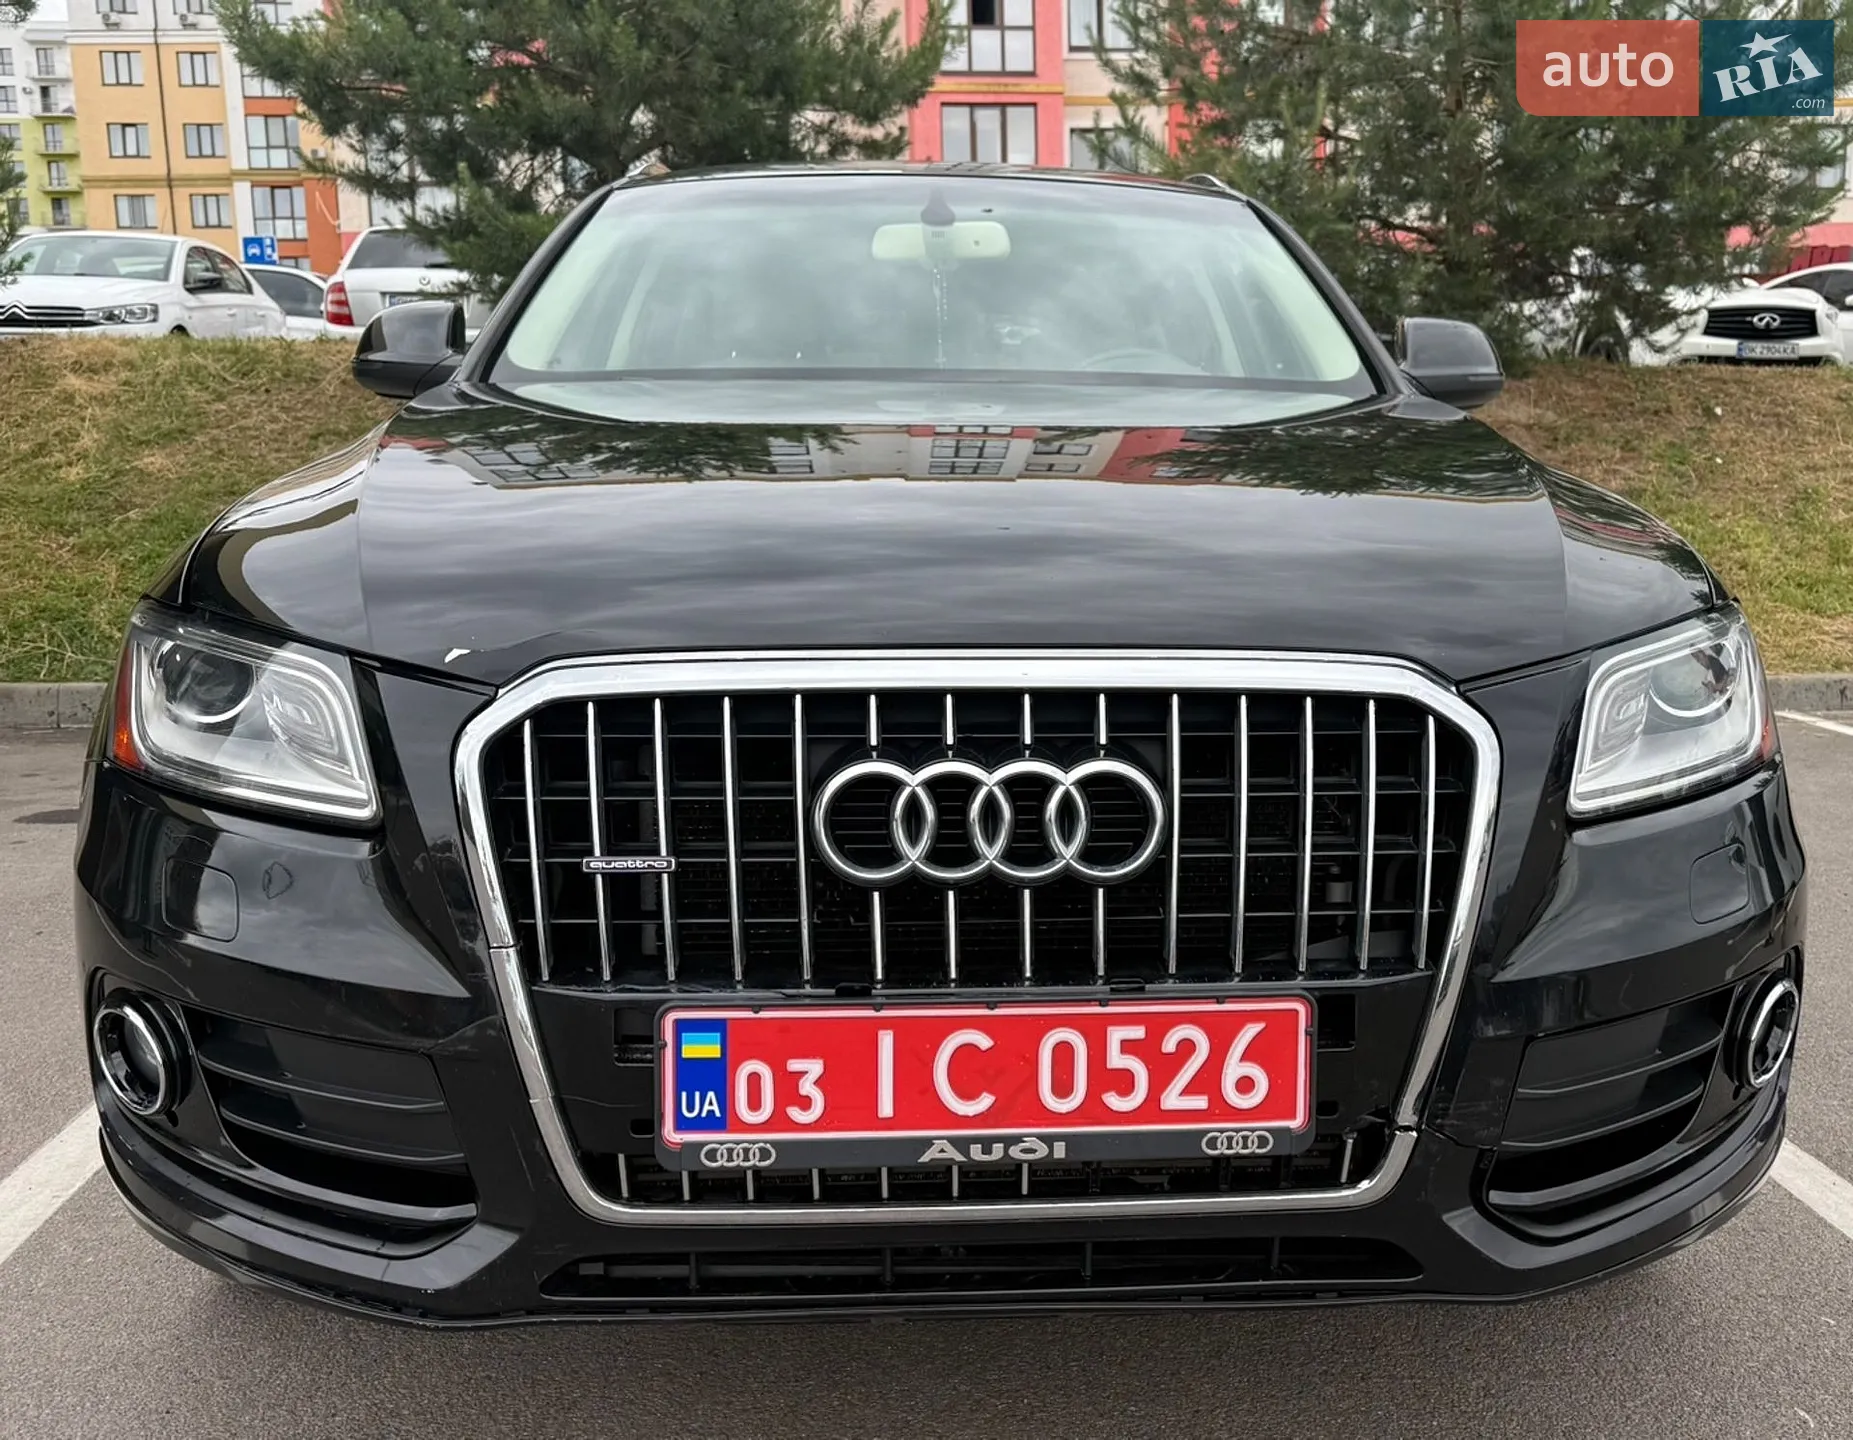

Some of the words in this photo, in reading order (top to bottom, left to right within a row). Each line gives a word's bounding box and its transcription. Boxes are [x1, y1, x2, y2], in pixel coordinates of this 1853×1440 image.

[589, 859, 668, 871] quattro
[681, 1091, 721, 1118] UA
[735, 1059, 825, 1124] 03
[1038, 1022, 1270, 1114] 0526
[917, 1137, 1067, 1163] Audi
